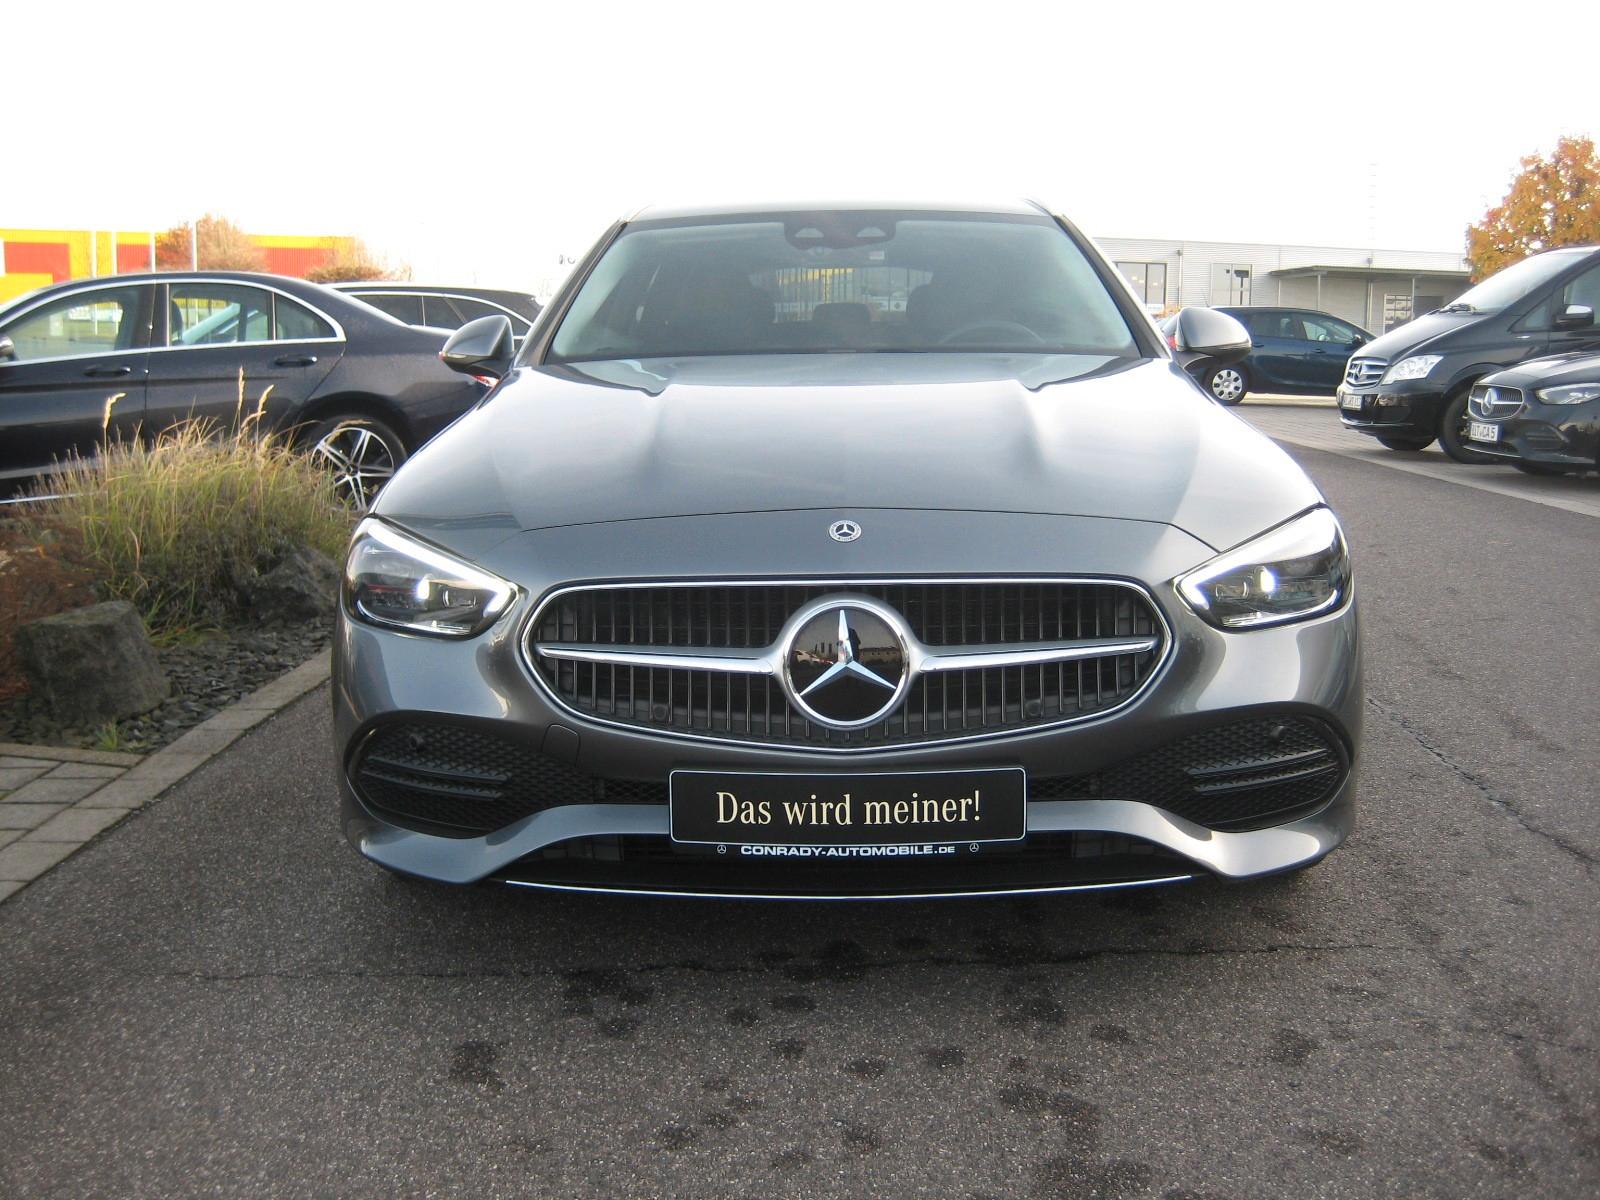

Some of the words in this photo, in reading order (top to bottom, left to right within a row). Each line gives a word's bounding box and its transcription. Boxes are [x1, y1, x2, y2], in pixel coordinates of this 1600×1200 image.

[716, 791, 772, 825] Das
[783, 794, 853, 826] wird
[863, 790, 981, 825] meiner!
[740, 845, 956, 857] CONRADY-AUTOMOBILE.DE
